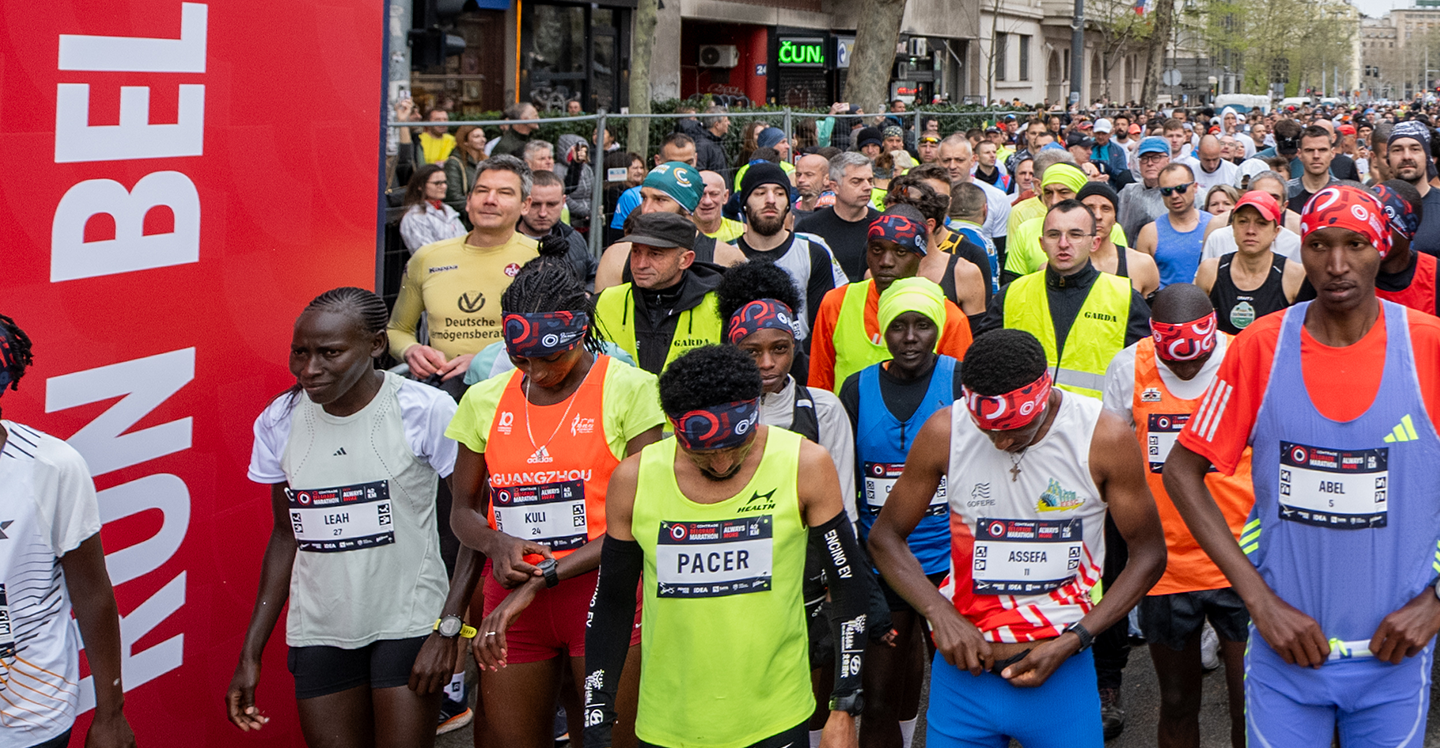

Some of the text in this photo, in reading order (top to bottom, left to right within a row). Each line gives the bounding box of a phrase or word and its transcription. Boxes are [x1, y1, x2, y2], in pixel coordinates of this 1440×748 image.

[779, 41, 824, 63] ČUN
[50, 1, 207, 283] BEL
[445, 316, 496, 327] Deutsche
[1084, 311, 1117, 323] GARDA
[674, 338, 709, 347] GARDA
[493, 469, 592, 485] GUANGZHOU
[1319, 480, 1345, 494] ABEL
[737, 503, 776, 514] HEALTH
[1329, 499, 1334, 507] 5
[324, 512, 350, 525] LEAH
[525, 511, 546, 524] KULI
[824, 529, 853, 579] ENCINO EV
[1008, 551, 1047, 563] ASSEFA
[677, 550, 749, 574] PACER
